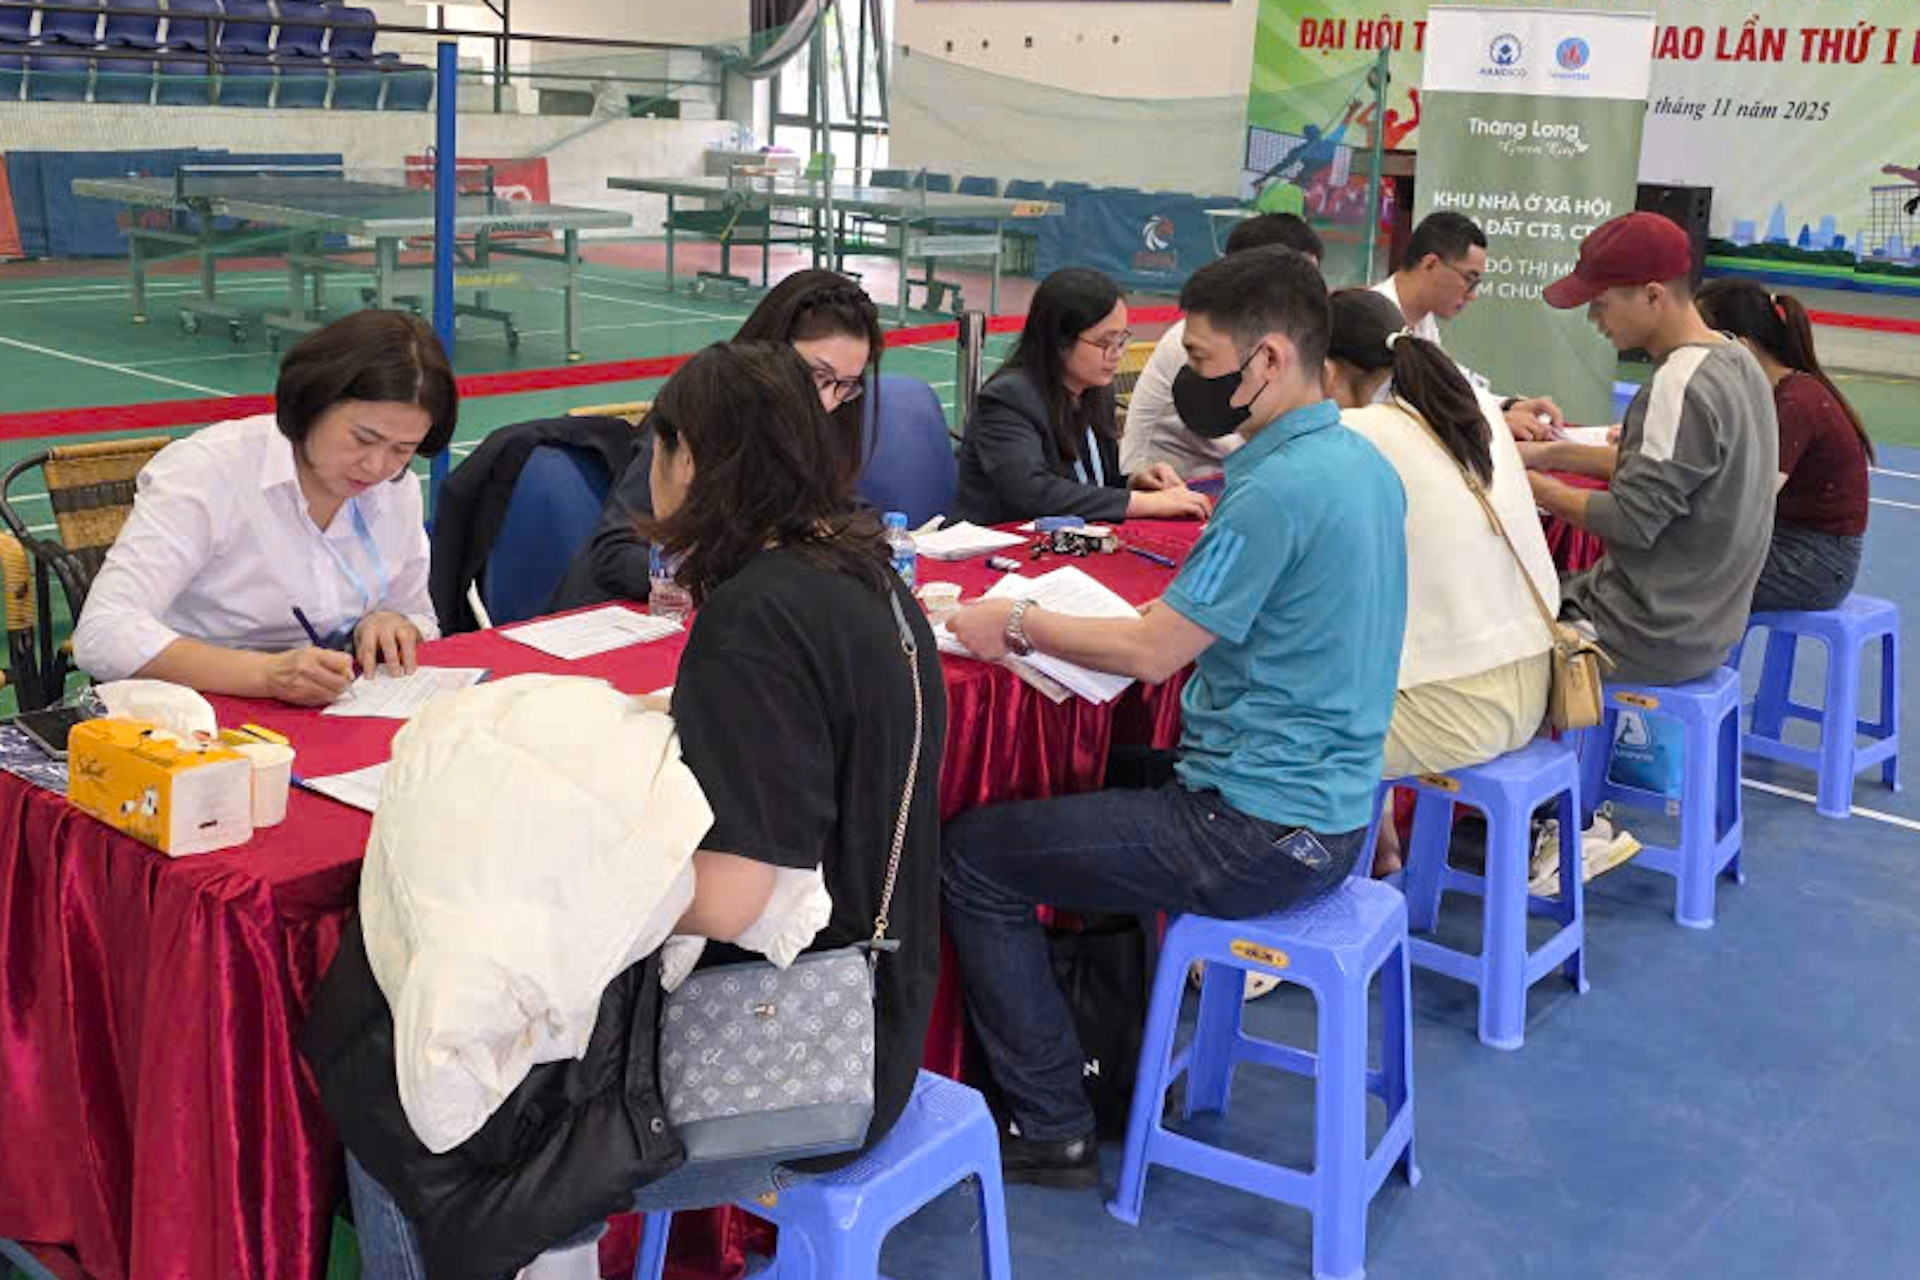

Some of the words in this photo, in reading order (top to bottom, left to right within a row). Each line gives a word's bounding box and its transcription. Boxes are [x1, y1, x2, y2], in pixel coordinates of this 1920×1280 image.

[1299, 18, 1346, 55] ĐẠI
[1413, 21, 1427, 51] T
[1652, 25, 1704, 59] IAO
[1714, 14, 1787, 62] LẦN
[1800, 21, 1876, 64] THỨ
[1881, 28, 1901, 64] I
[1654, 96, 1706, 121] tháng
[1711, 98, 1730, 117] 11
[1736, 103, 1778, 120] năm
[1782, 101, 1831, 121] 2025
[1532, 120, 1579, 143] Long
[1433, 192, 1475, 209] KHU
[1477, 191, 1521, 211] NHÀ
[1544, 195, 1572, 214] XÃ
[1575, 196, 1612, 217] HỘI
[1570, 224, 1597, 240] CT
[1499, 282, 1543, 299] CHU
